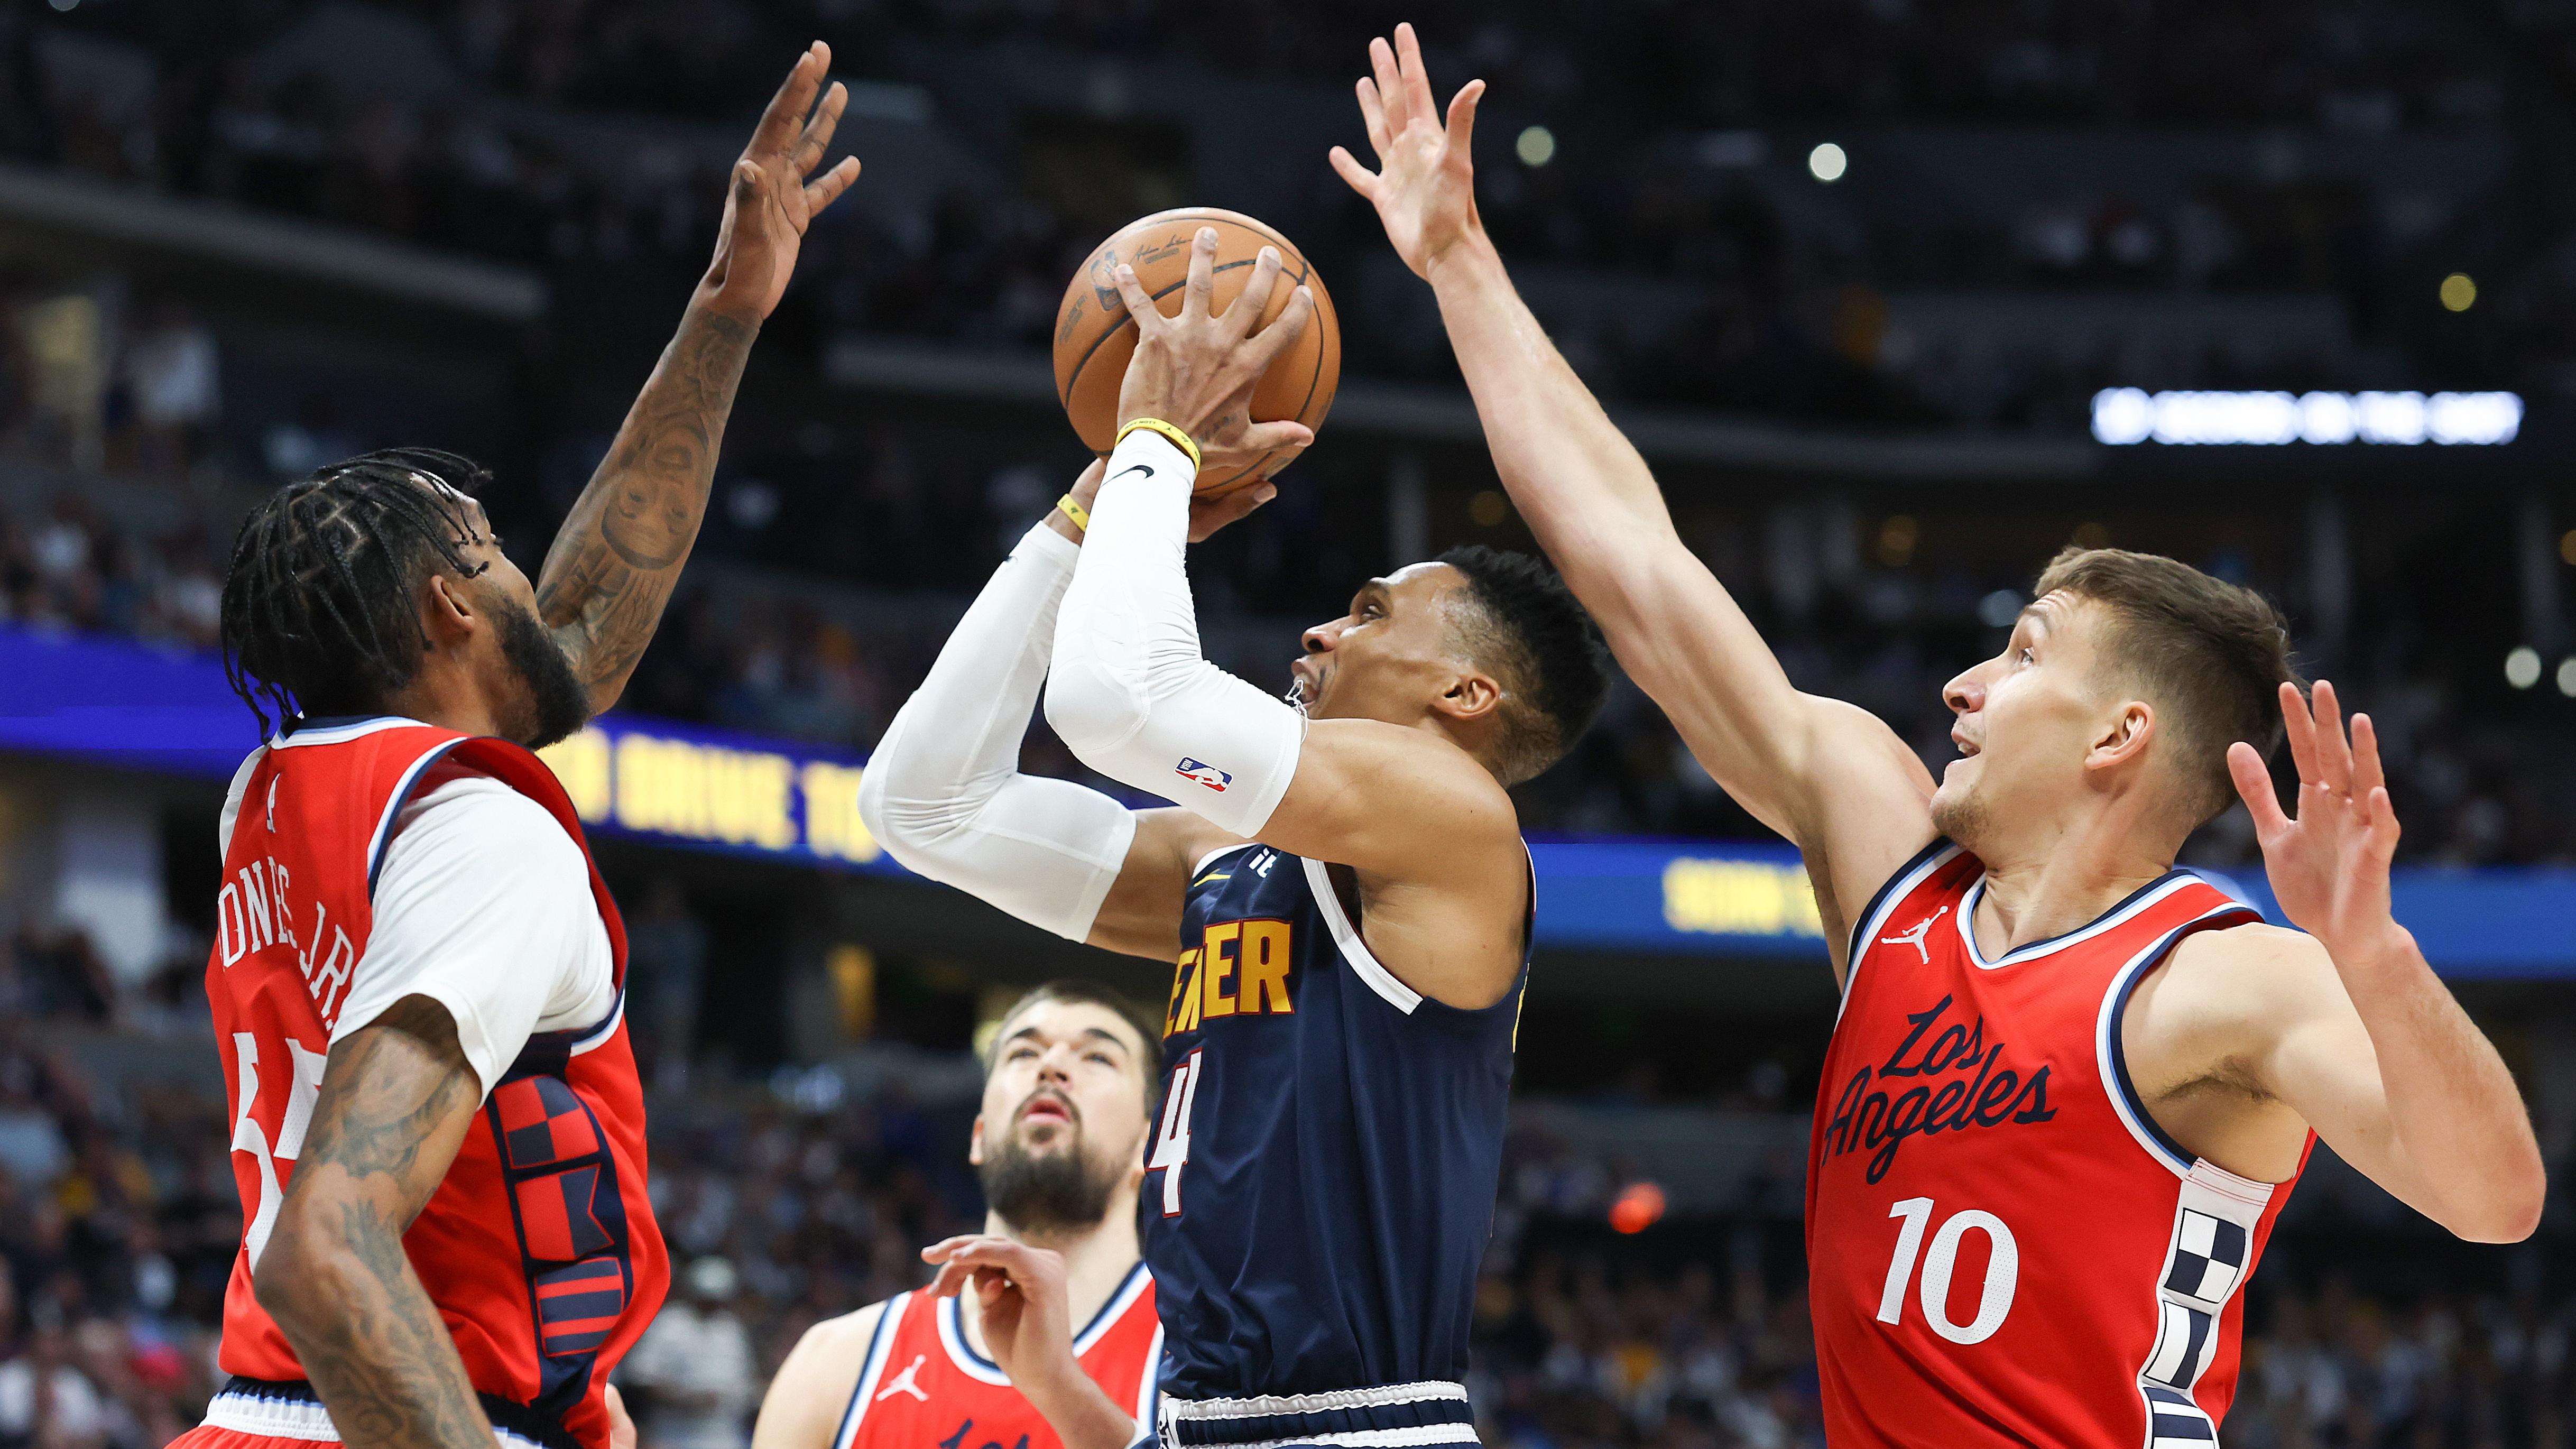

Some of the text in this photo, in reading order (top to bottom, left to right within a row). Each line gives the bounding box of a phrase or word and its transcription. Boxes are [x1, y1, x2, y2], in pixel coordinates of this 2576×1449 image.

[1179, 759, 1194, 770] NBA
[217, 855, 298, 972] ONES
[1878, 994, 1985, 1079] Los
[1147, 1047, 1203, 1218] 4
[1821, 1043, 2058, 1186] Angeles
[1876, 1197, 2019, 1345] 10
